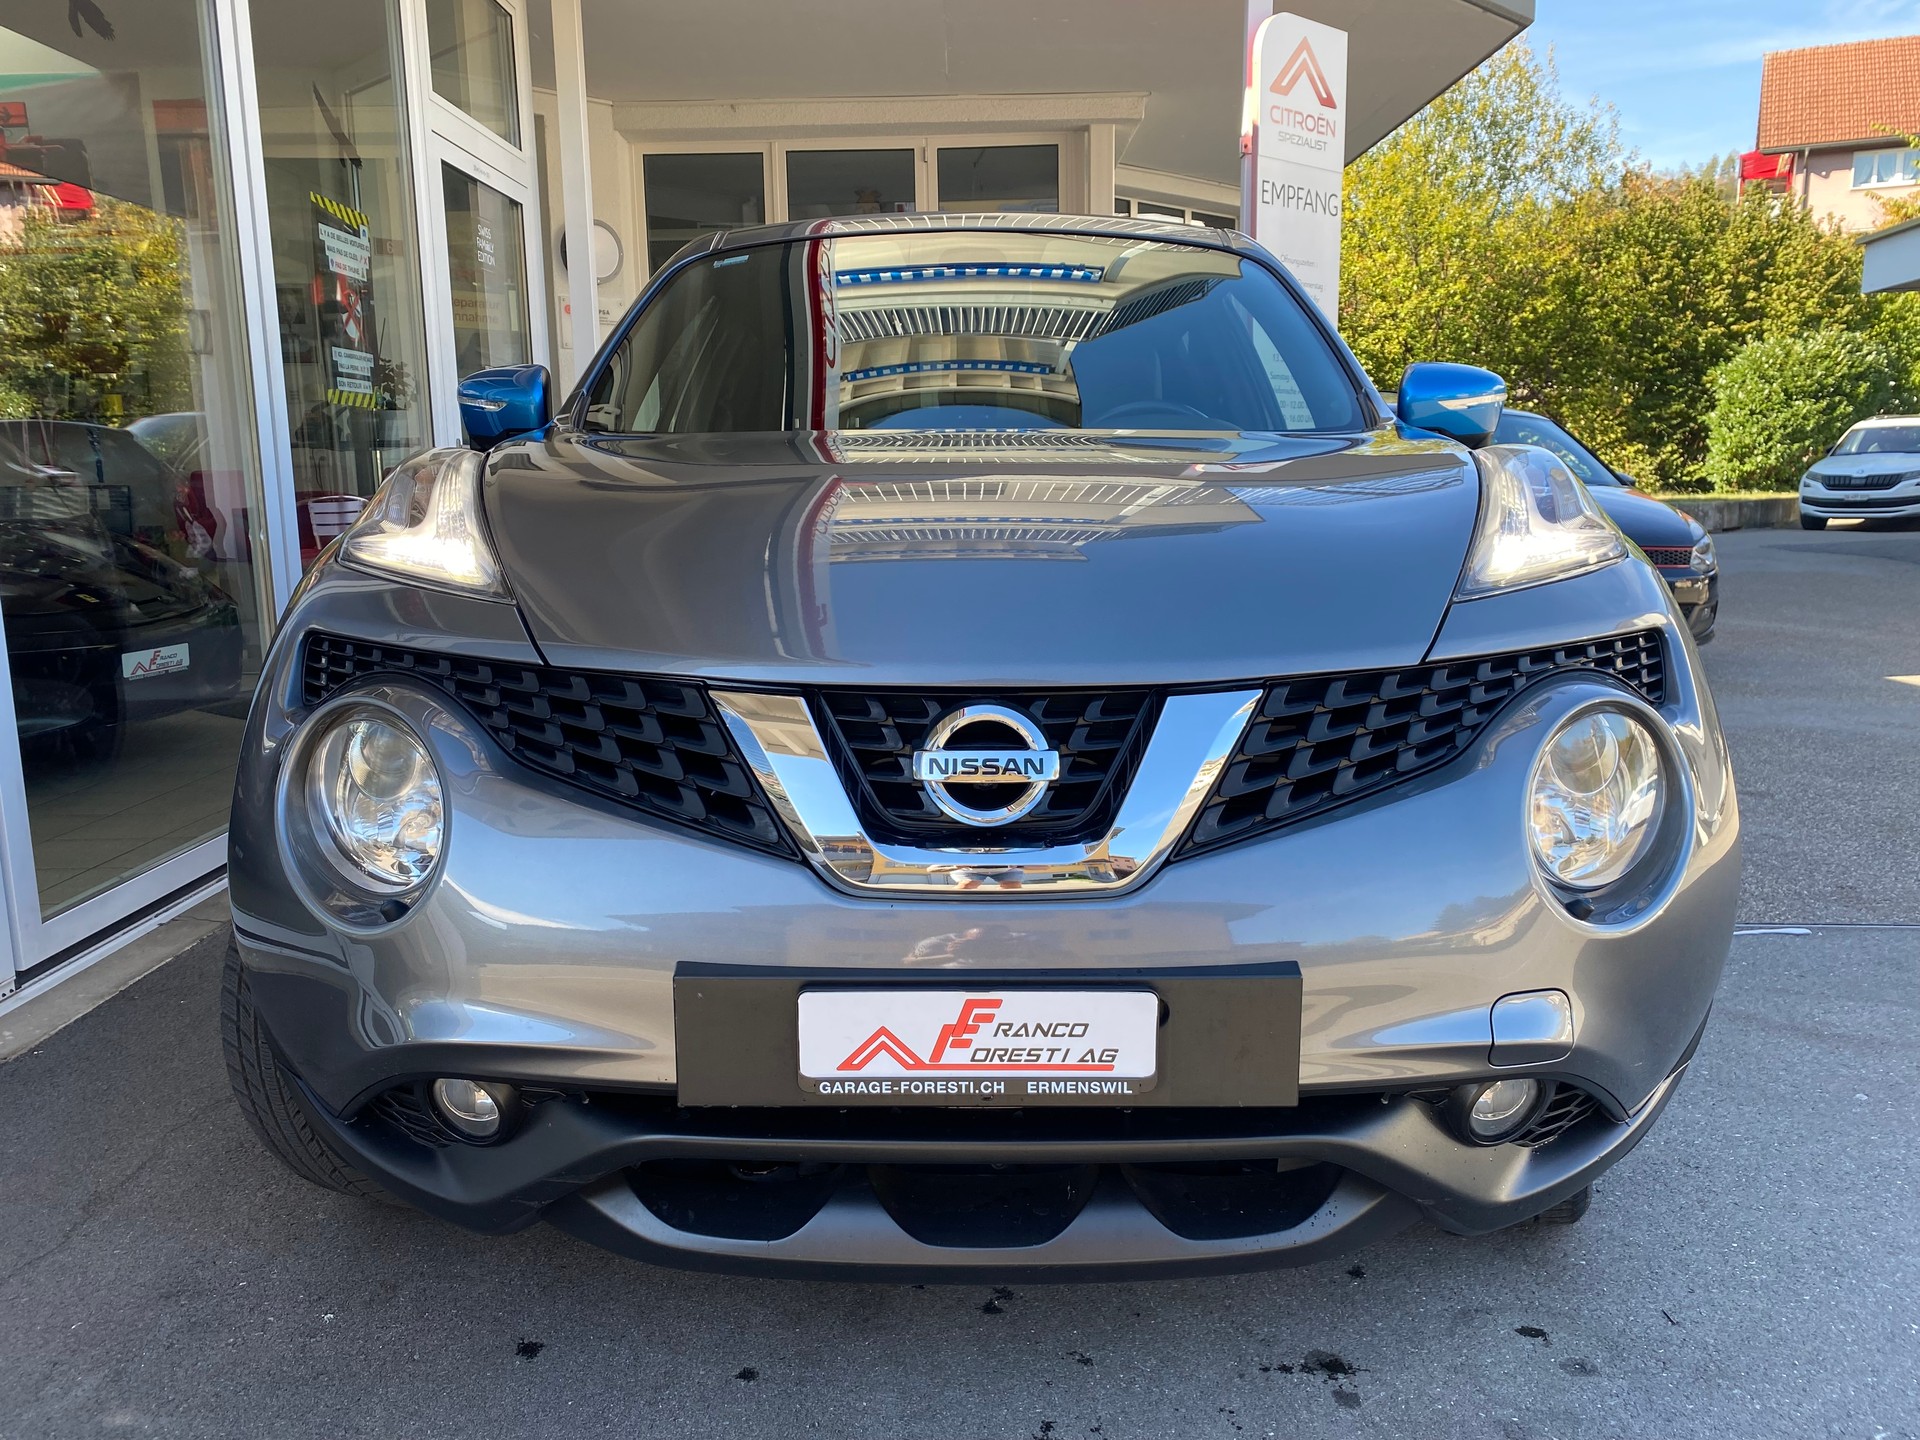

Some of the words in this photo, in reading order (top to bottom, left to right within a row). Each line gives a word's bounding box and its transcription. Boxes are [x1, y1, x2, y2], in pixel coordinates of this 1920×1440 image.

[1270, 105, 1336, 138] CITROËN
[1278, 131, 1328, 151] SPEZIALIST
[1261, 180, 1339, 217] EMPFANG
[477, 250, 495, 266] EDITION
[453, 298, 502, 309] eparatur
[455, 312, 499, 324] nnahme
[928, 757, 1044, 775] NISSAN
[952, 998, 1090, 1038] FRANCO
[928, 1023, 1071, 1063] FORESTI
[1076, 1048, 1119, 1063] AG
[819, 1081, 1005, 1095] GARAGE-FORESTI.CH
[1026, 1081, 1133, 1095] ERMENSWIL
